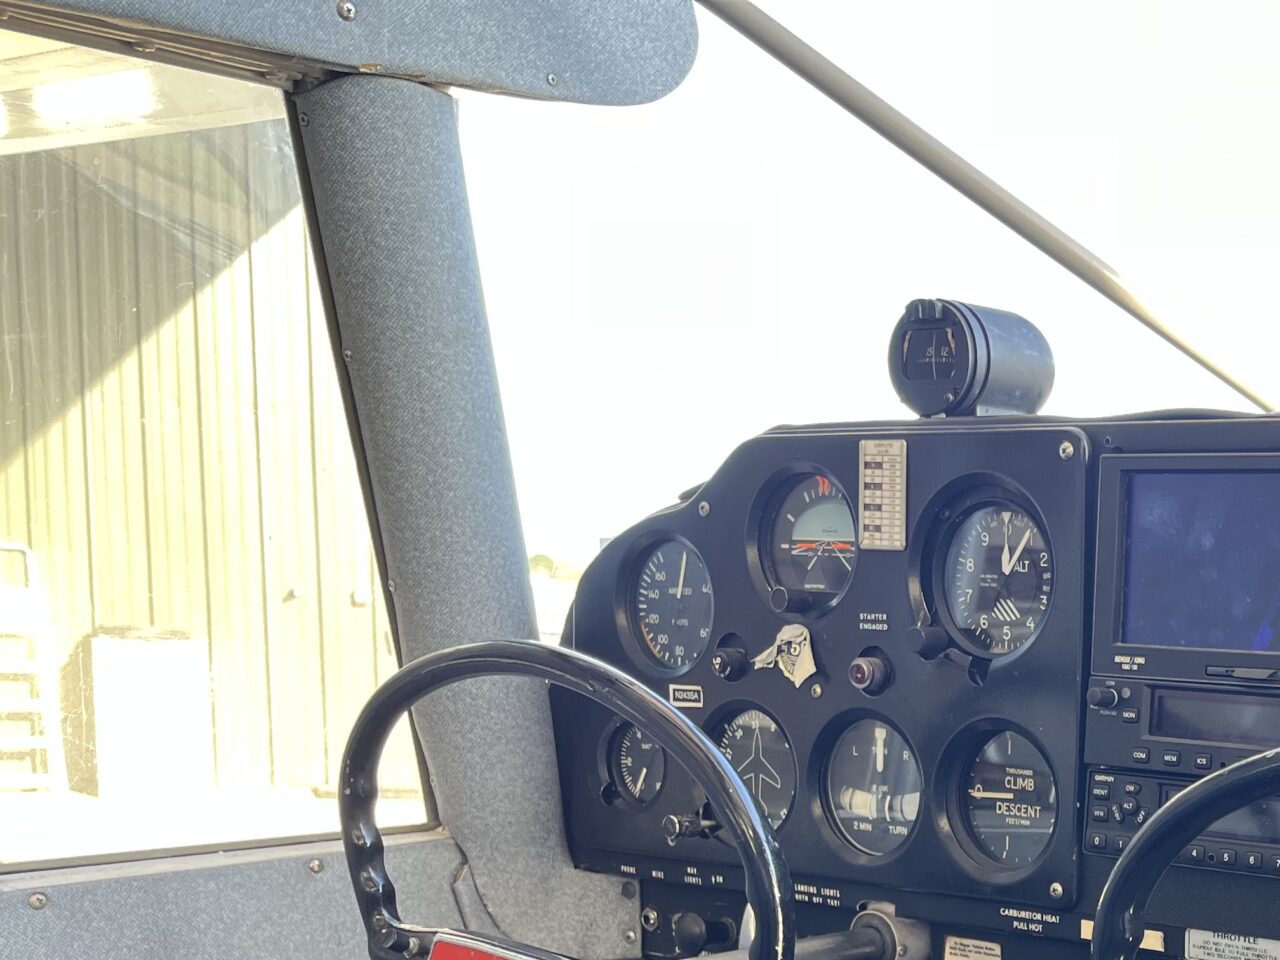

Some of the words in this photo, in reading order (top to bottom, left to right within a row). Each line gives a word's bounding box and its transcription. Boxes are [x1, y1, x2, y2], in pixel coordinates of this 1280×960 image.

[1013, 560, 1030, 573] ALT
[1006, 768, 1033, 776] THOUSANDS
[1004, 776, 1034, 791] CLIMB
[996, 801, 1041, 818] DESCENT
[854, 821, 859, 830] 2
[860, 822, 872, 831] MIN
[889, 826, 907, 836] TURN
[684, 876, 702, 885] LIGHTS
[794, 884, 816, 894] LANDING
[821, 888, 840, 897] LIGHTS
[1000, 908, 1042, 921] CARBURETOR
[1043, 914, 1060, 924] HEAT
[1013, 922, 1028, 931] PULL
[1029, 924, 1043, 932] HOT
